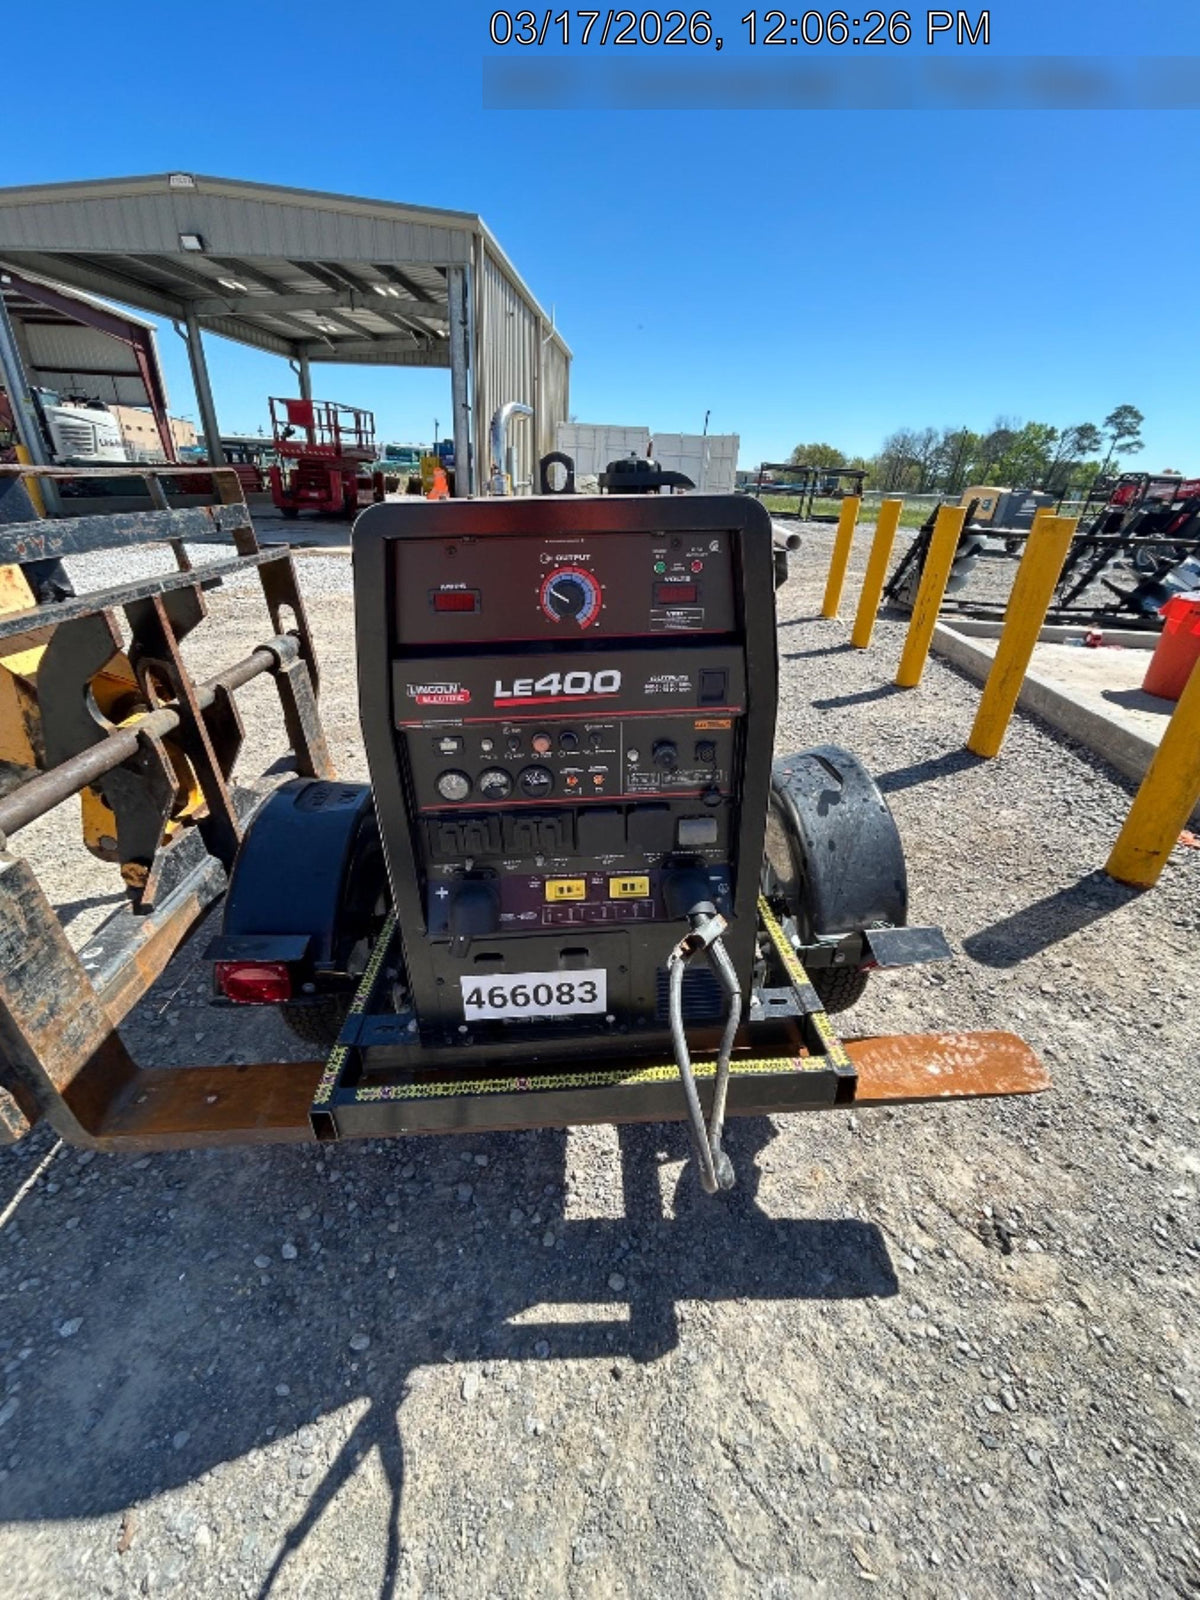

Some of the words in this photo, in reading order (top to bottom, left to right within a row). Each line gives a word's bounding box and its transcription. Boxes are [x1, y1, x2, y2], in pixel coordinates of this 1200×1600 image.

[410, 684, 458, 696] LINCOLN
[494, 669, 622, 698] LE400
[422, 694, 466, 703] ELECTRIC
[465, 980, 599, 1009] 466083
